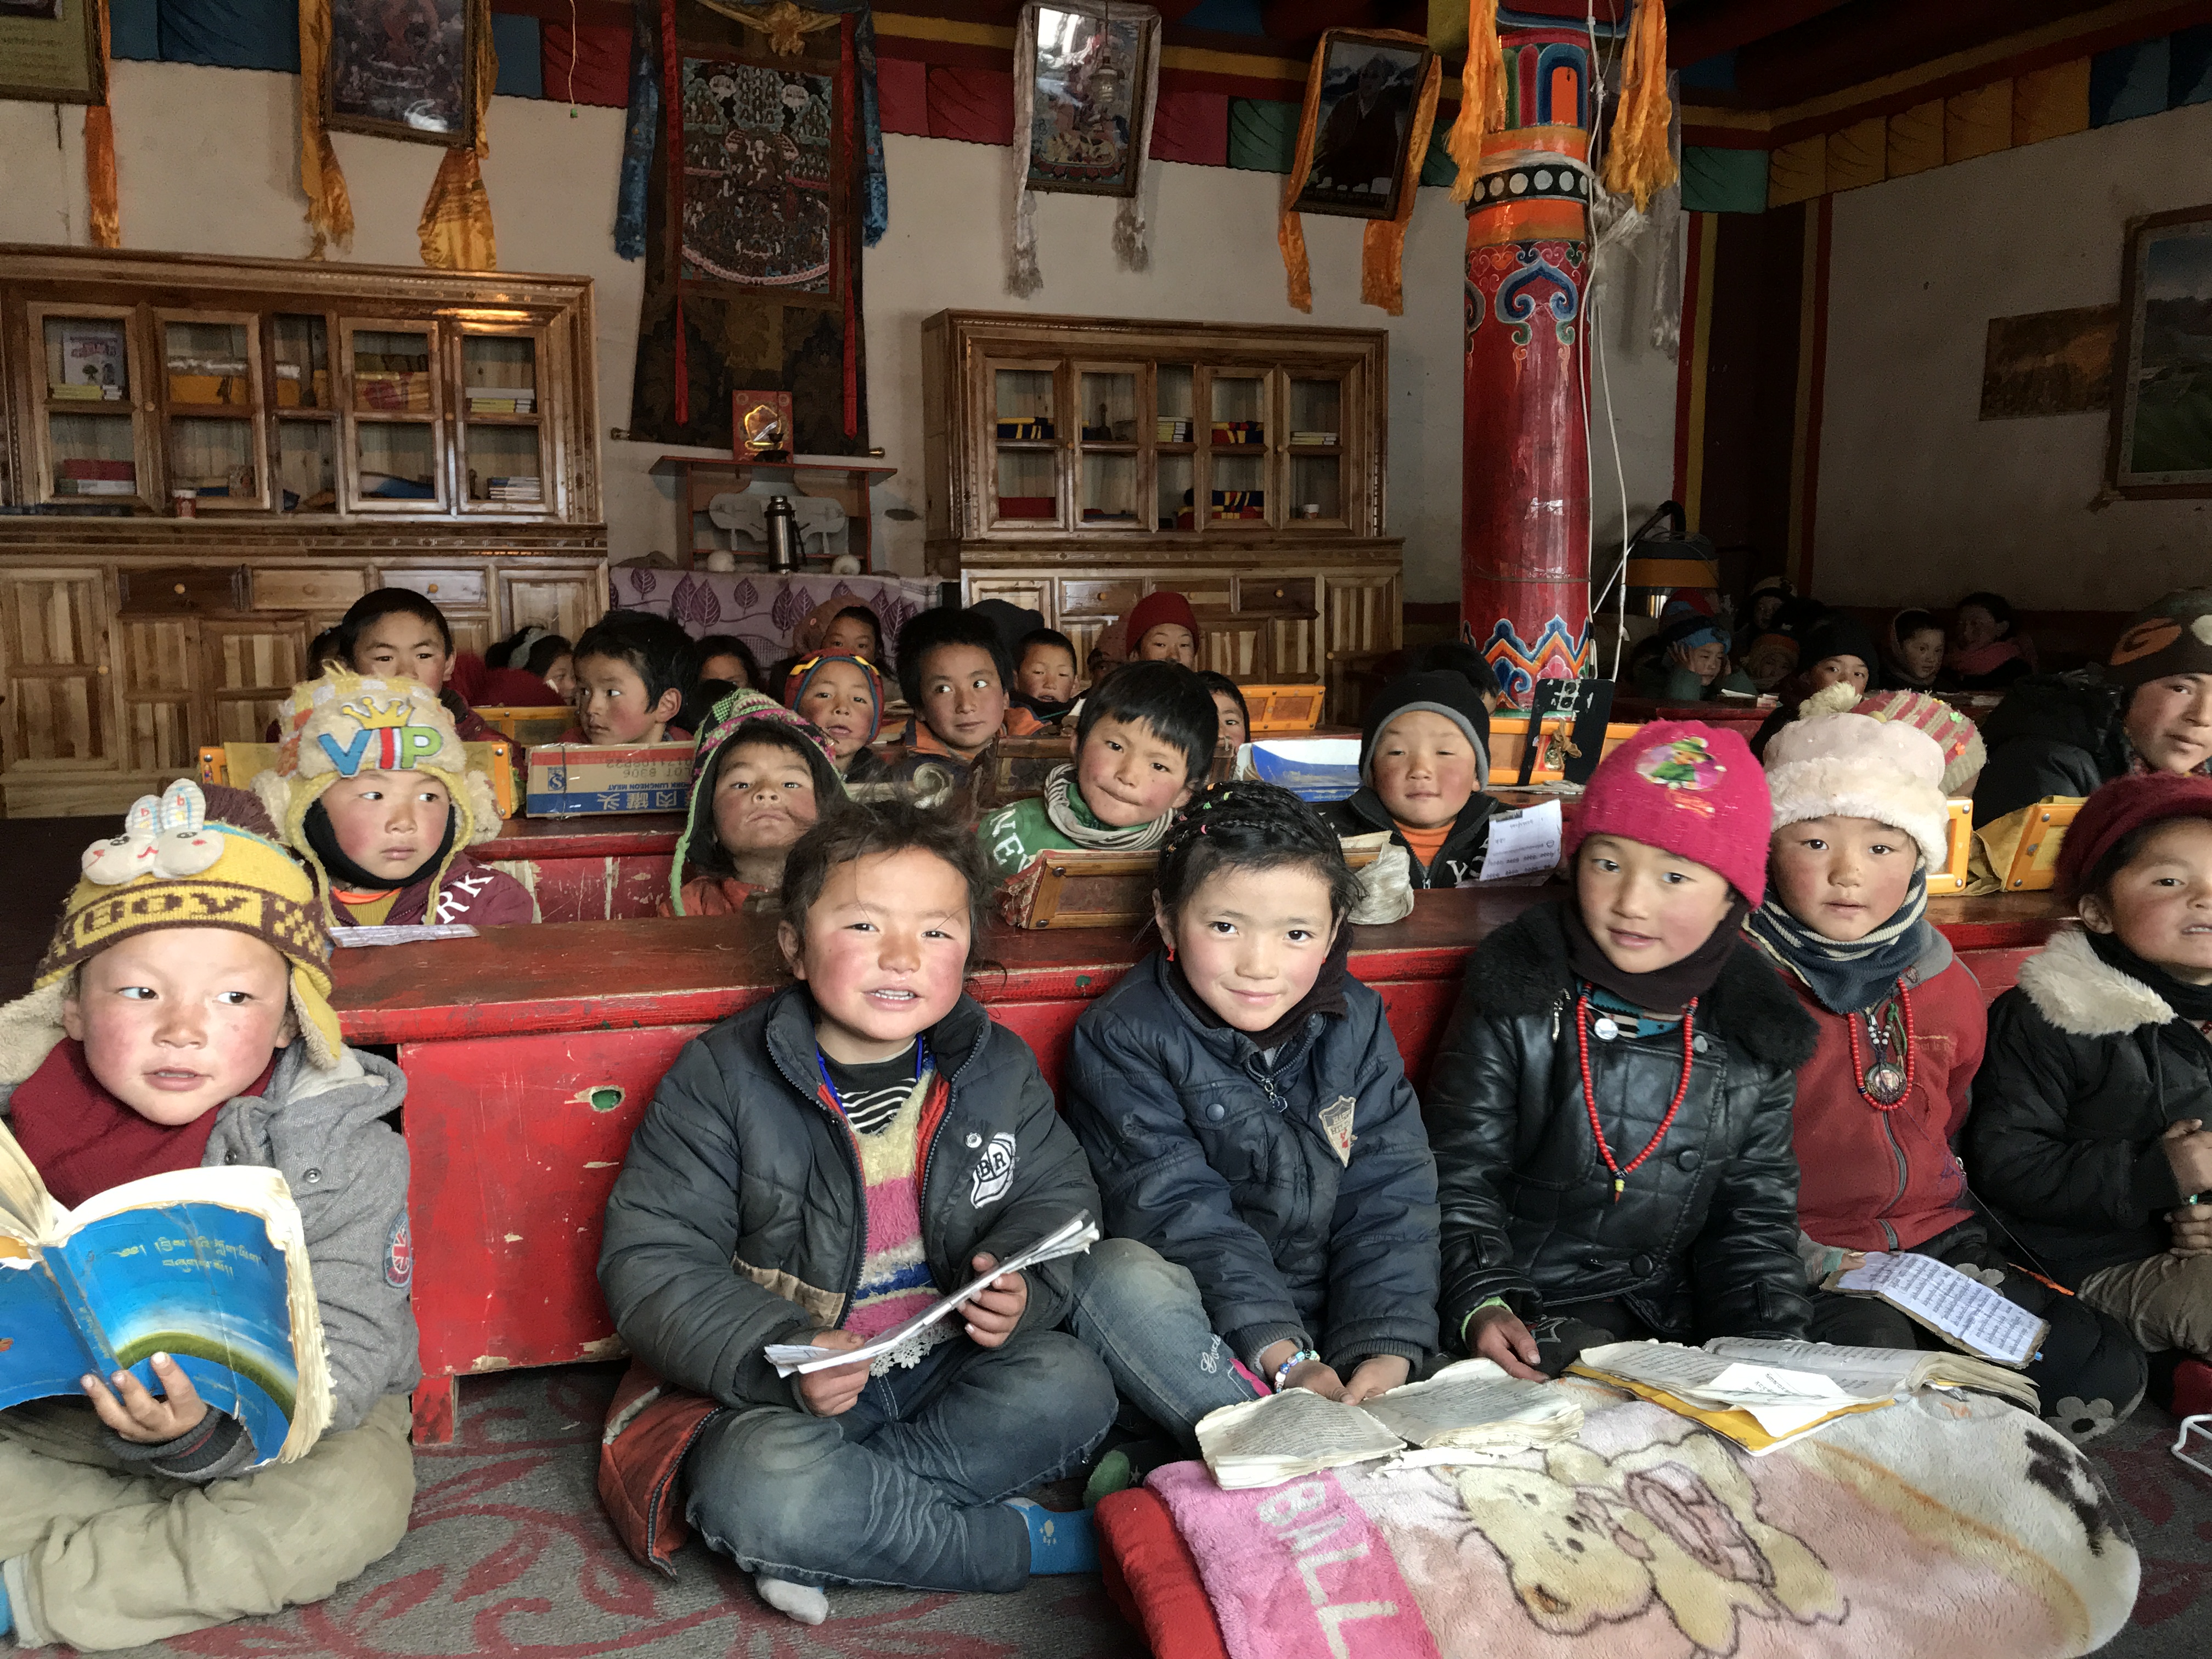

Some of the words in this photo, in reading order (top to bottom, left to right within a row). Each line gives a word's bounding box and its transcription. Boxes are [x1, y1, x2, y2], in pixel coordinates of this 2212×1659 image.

[317, 725, 444, 777] VIP
[597, 791, 690, 810] 肉罐头
[83, 893, 249, 934] BOY
